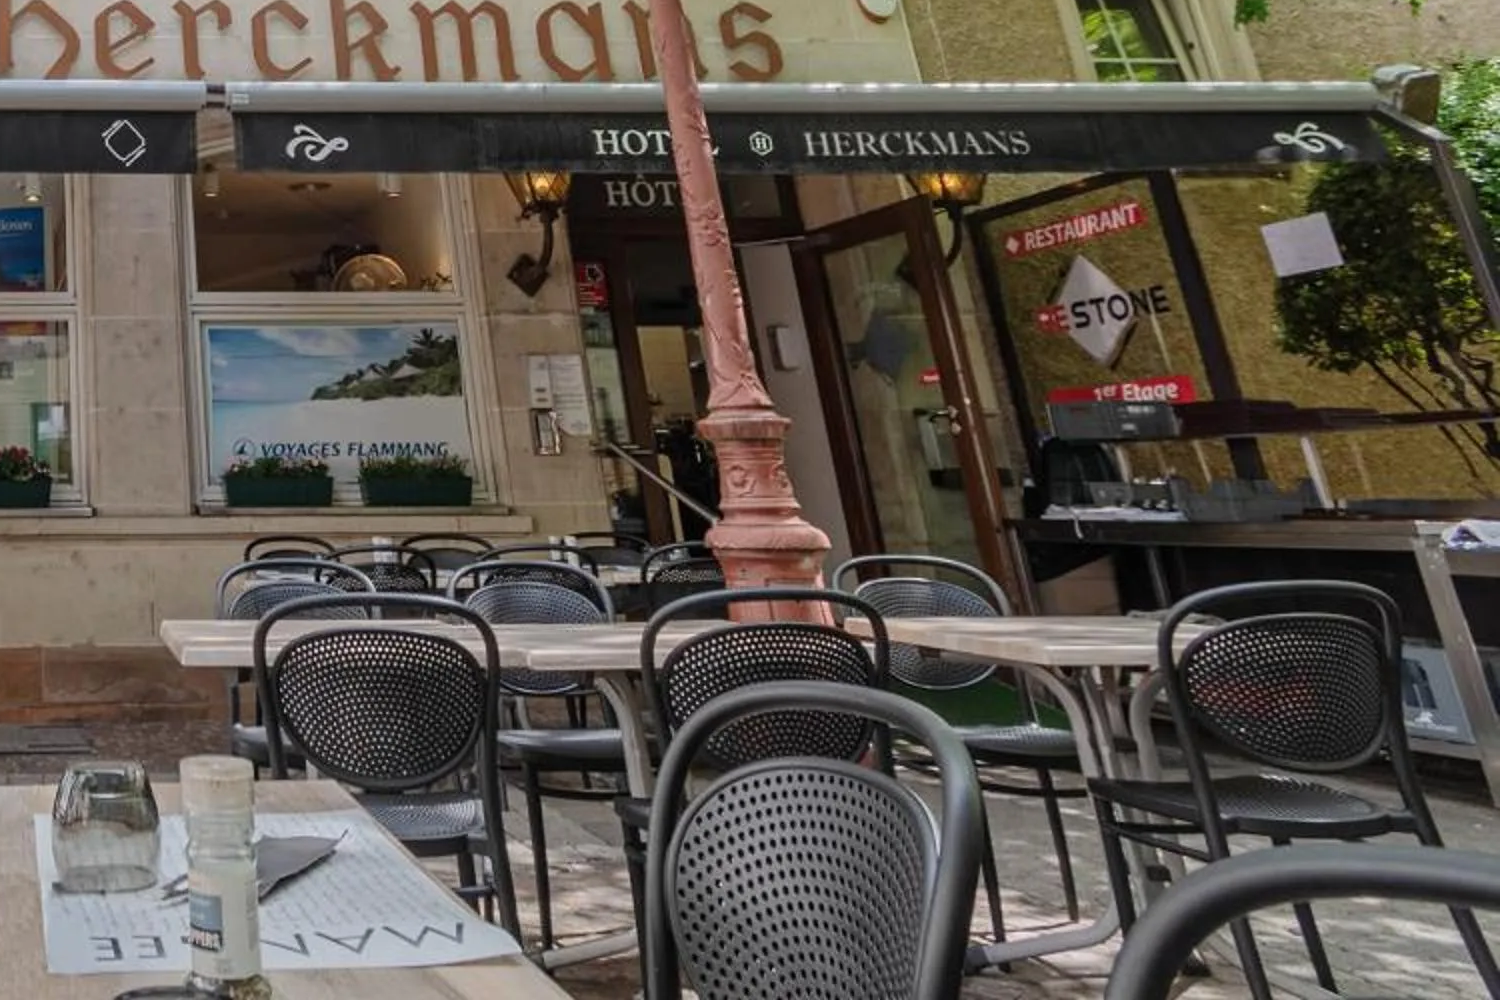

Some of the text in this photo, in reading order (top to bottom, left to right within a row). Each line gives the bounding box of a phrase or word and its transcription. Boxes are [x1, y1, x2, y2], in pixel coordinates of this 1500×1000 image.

[592, 128, 719, 156] HOT
[804, 130, 1031, 157] HERCKMANS
[604, 173, 680, 208] HÔT
[1024, 203, 1138, 251] RESTAURANT
[261, 440, 449, 458] VOYAGES FLAMMANG
